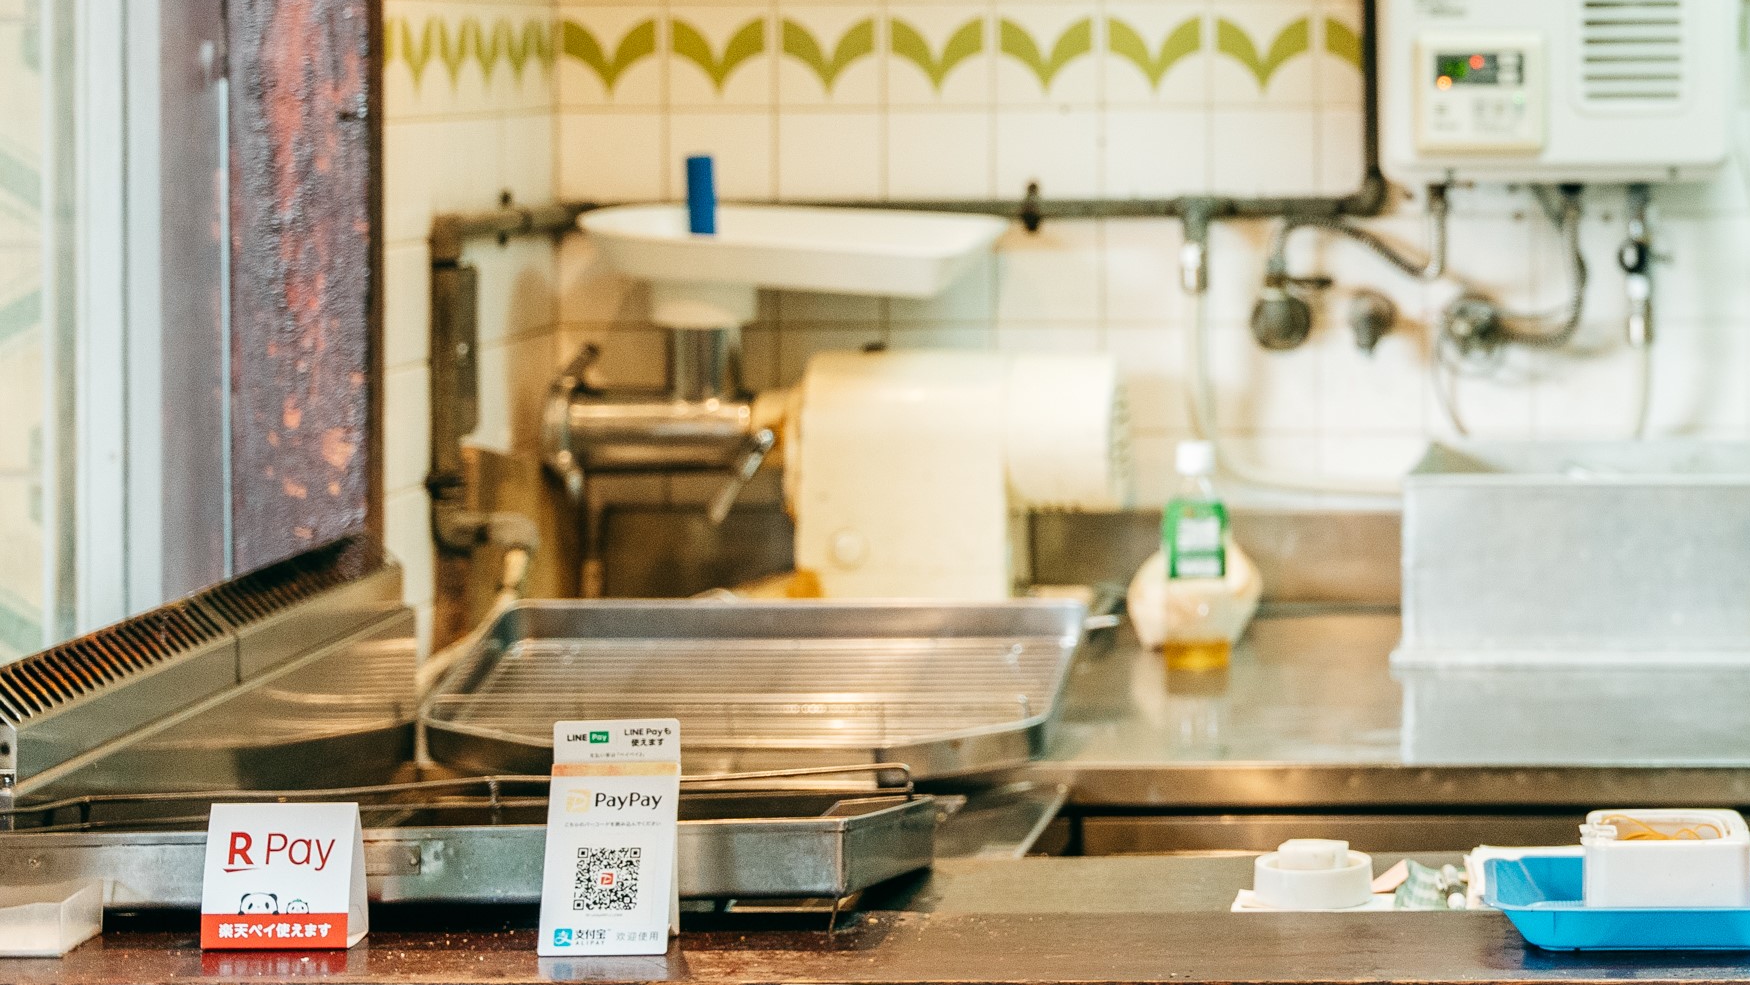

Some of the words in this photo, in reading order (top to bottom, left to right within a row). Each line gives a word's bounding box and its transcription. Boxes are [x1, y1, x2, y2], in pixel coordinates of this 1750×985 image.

[567, 734, 588, 742] LINE
[591, 733, 609, 743] Pay
[624, 728, 644, 736] LINE
[631, 738, 665, 747] 使えます
[595, 792, 663, 809] PayPay
[228, 831, 253, 866] R
[266, 833, 336, 872] Pay
[218, 922, 332, 940] 楽天ペイ使えます
[576, 928, 606, 940] 支付宝
[616, 931, 659, 942] 欢迎使用
